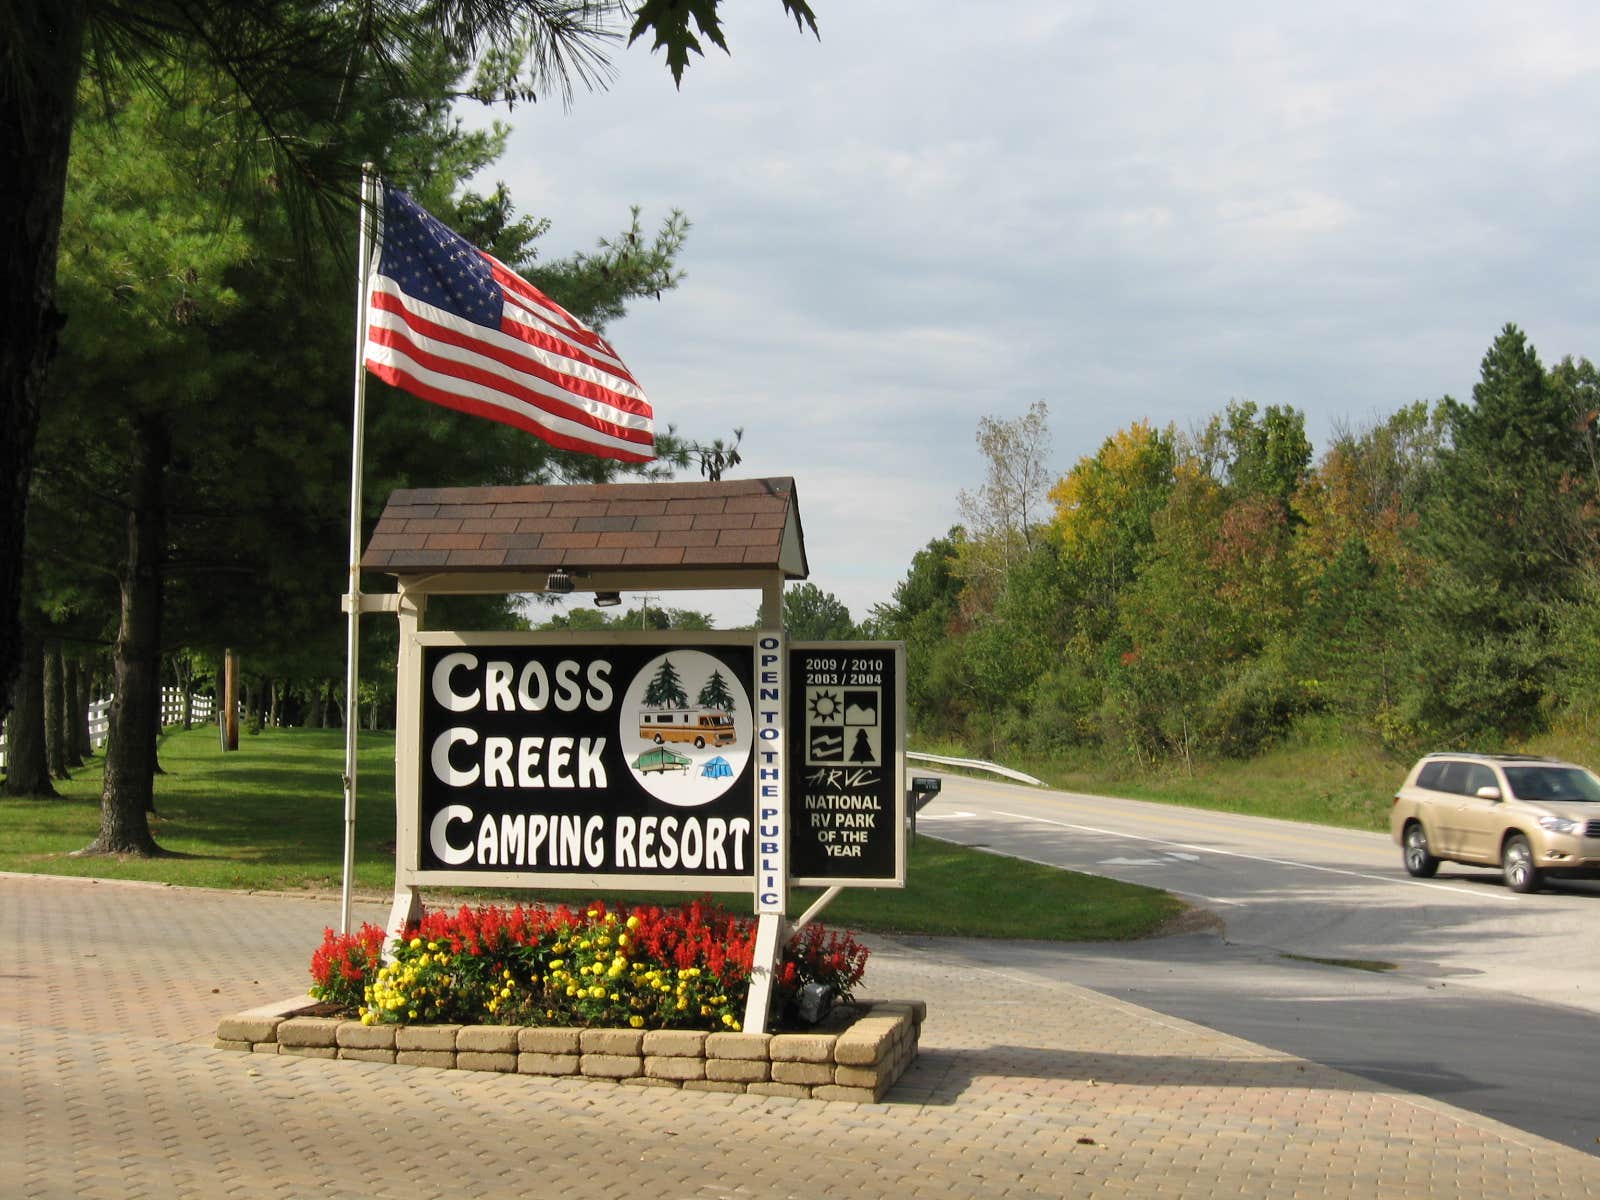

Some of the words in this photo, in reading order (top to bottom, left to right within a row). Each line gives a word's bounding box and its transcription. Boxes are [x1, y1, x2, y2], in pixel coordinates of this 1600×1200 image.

[759, 637, 780, 701] OPEN
[805, 659, 837, 671] 2009
[851, 659, 883, 671] 2010
[431, 652, 614, 712] CROSS
[806, 674, 838, 685] 2003
[850, 674, 882, 685] 2004
[759, 711, 780, 741] TO
[430, 726, 608, 788] CREEK
[759, 751, 779, 798] THE
[805, 768, 881, 790] ARVC
[805, 795, 882, 810] NATIONAL
[810, 813, 831, 828] RV
[835, 813, 875, 828] PARK
[429, 804, 604, 868] CAMPING
[615, 815, 751, 870] RESORT
[817, 830, 837, 843] OF
[840, 830, 868, 843] THE
[760, 808, 779, 905] PUBLIC
[824, 844, 862, 857] YEAR
